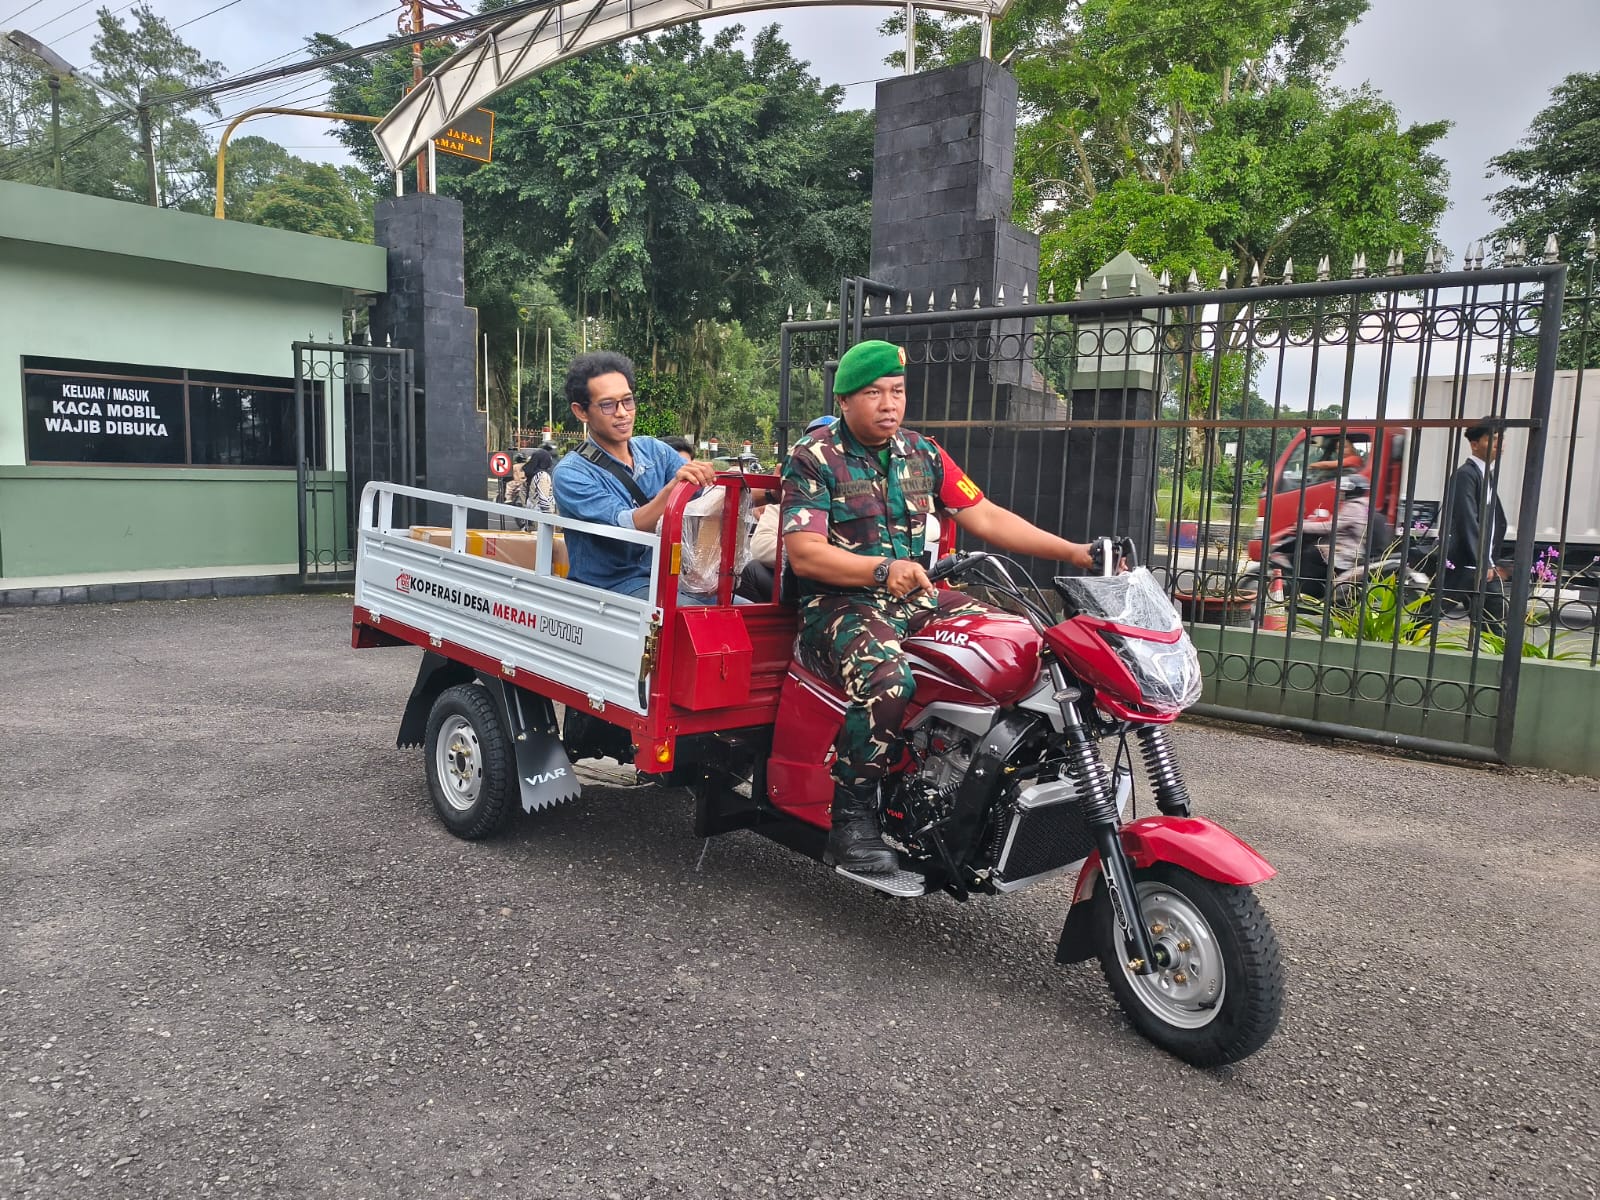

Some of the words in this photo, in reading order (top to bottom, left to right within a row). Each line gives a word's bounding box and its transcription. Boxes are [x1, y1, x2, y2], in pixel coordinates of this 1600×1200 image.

[447, 129, 483, 144] JARAK
[62, 384, 105, 400] KELUAR
[113, 388, 150, 402] MASUK
[52, 401, 102, 417] KACA
[107, 404, 161, 420] MOBIL
[44, 418, 101, 434] WAJIB
[106, 421, 168, 437] DIBUKA
[410, 576, 462, 605] KOPERASI
[463, 593, 490, 614] DESA
[492, 602, 537, 629] MERAH
[540, 615, 584, 645] PUTIH
[935, 629, 969, 646] VIAR
[525, 767, 567, 786] VIAR
